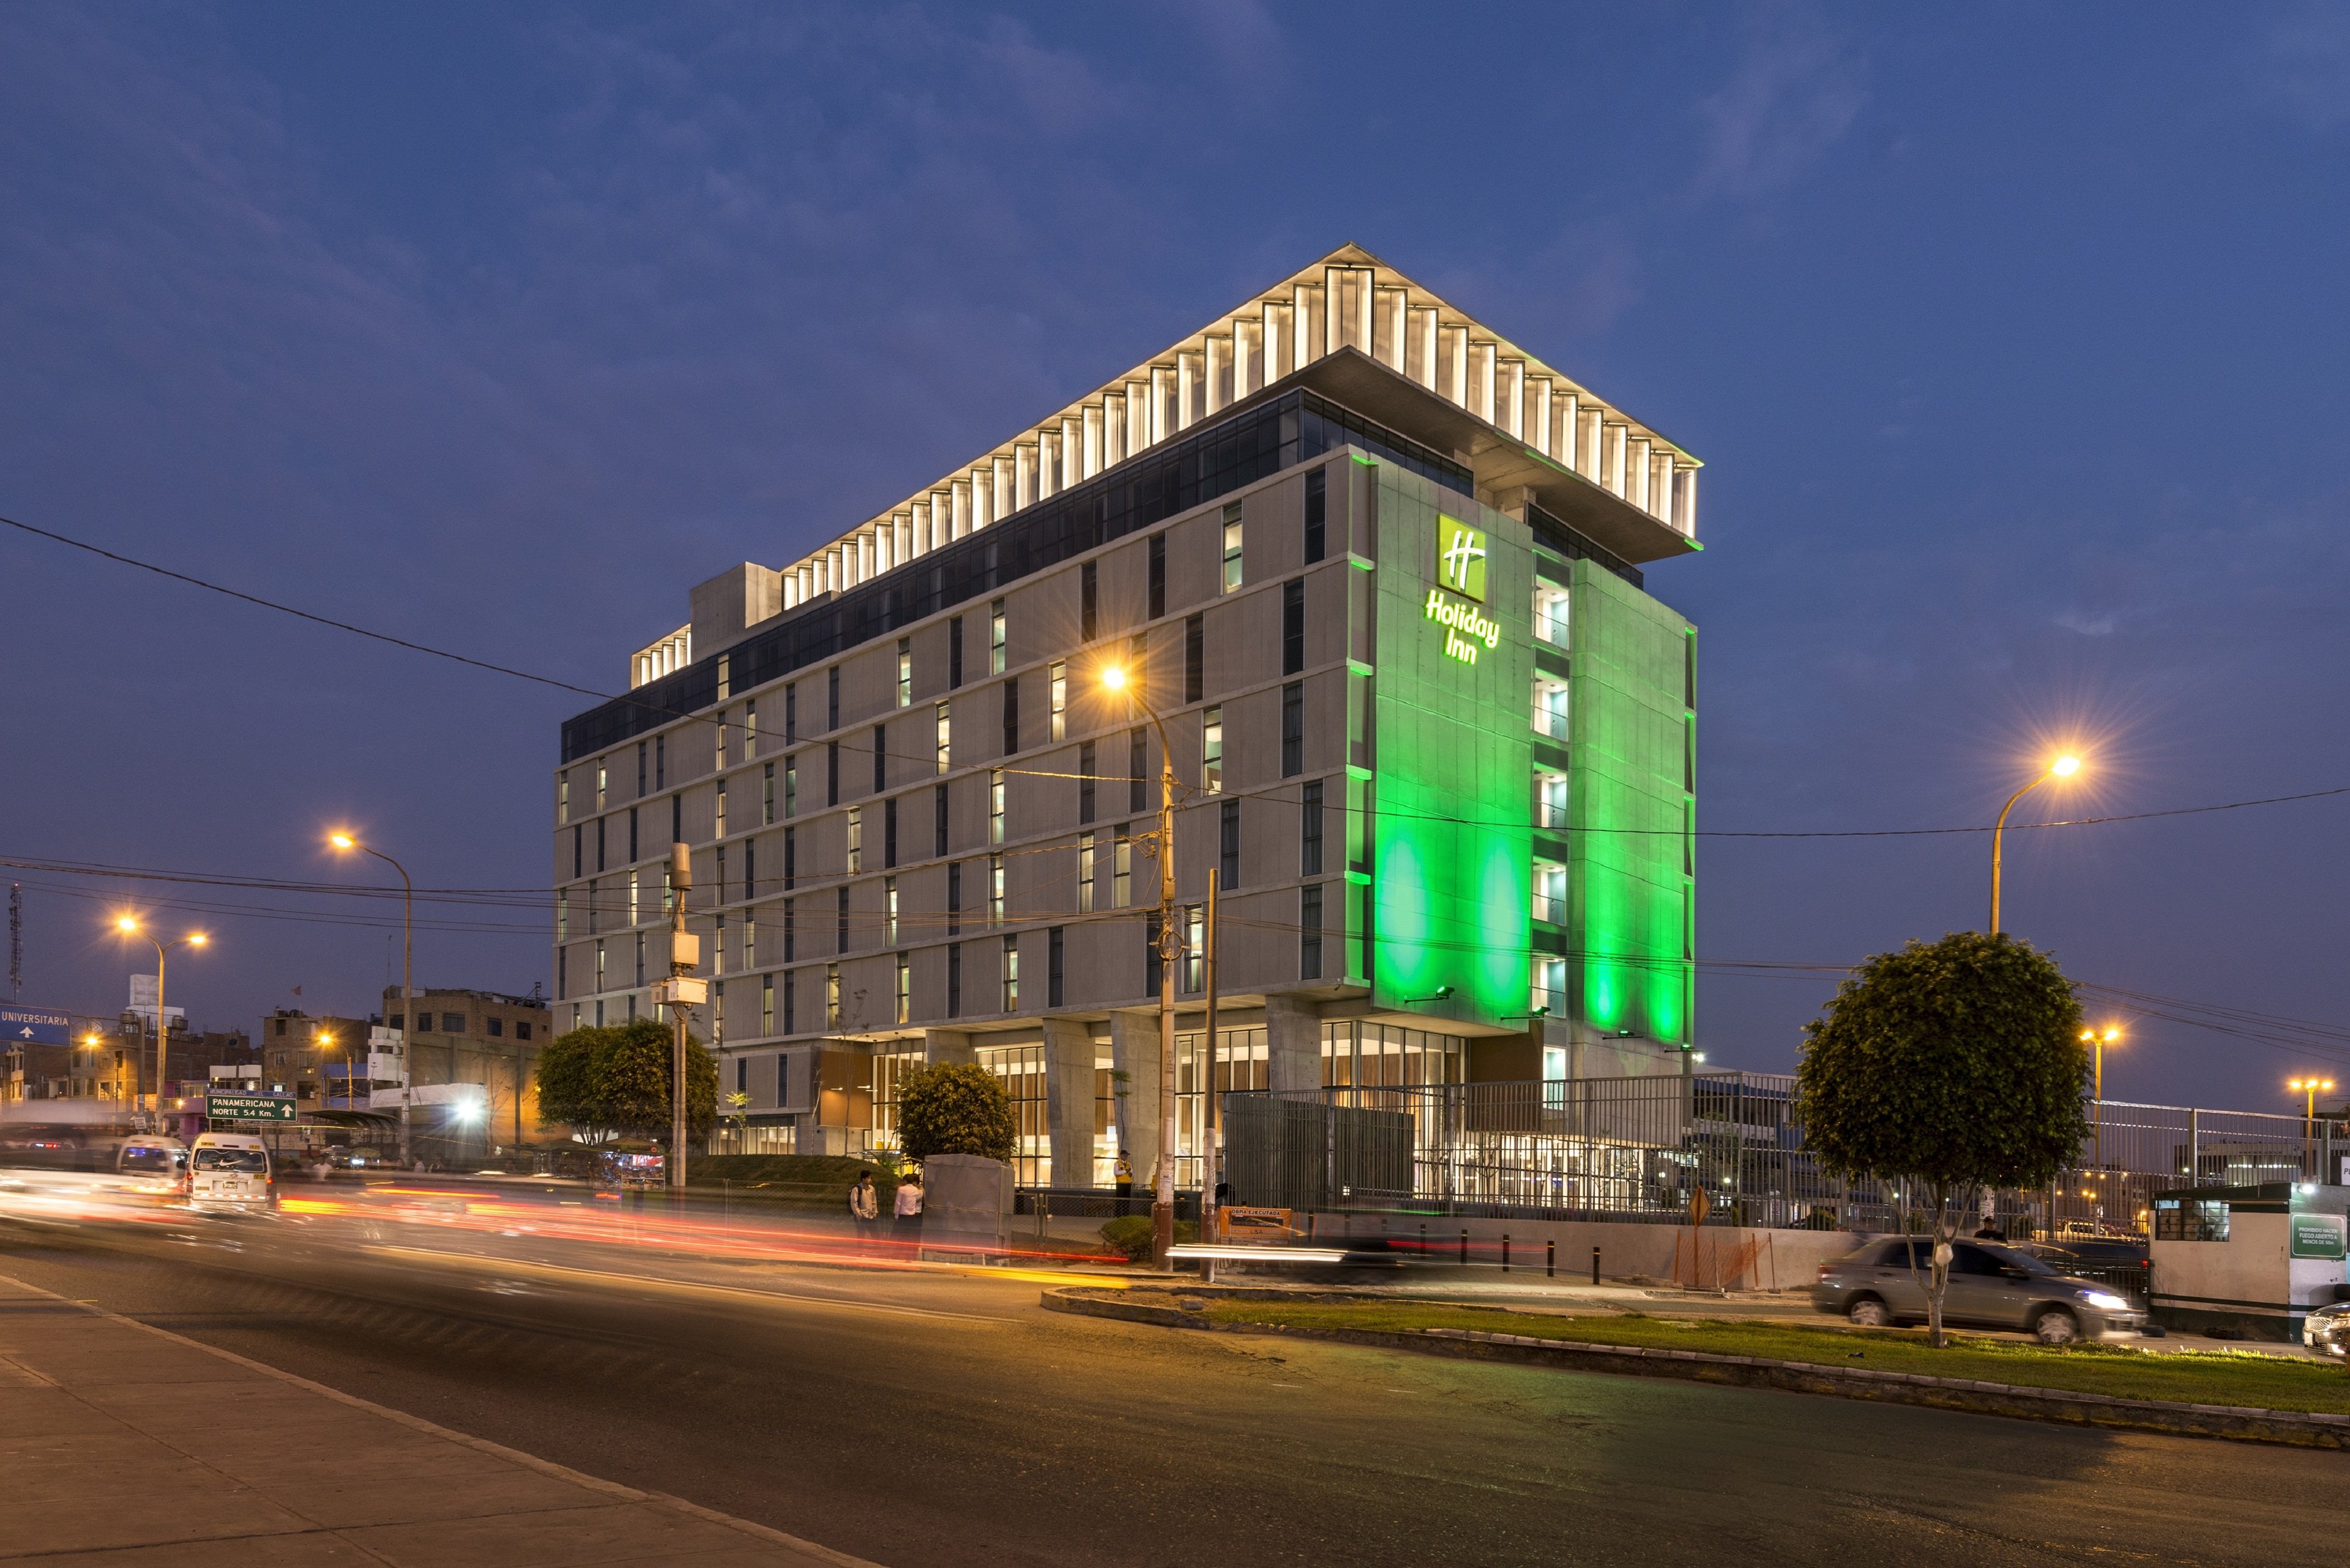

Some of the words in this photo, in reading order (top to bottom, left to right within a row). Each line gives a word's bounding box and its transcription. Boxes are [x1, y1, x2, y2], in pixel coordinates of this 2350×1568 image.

[1426, 589, 1500, 649] Holiday
[1444, 627, 1478, 665] Inn
[2, 1011, 69, 1026] UNIVERSITARIA
[212, 1099, 275, 1108] PANAMERICANA
